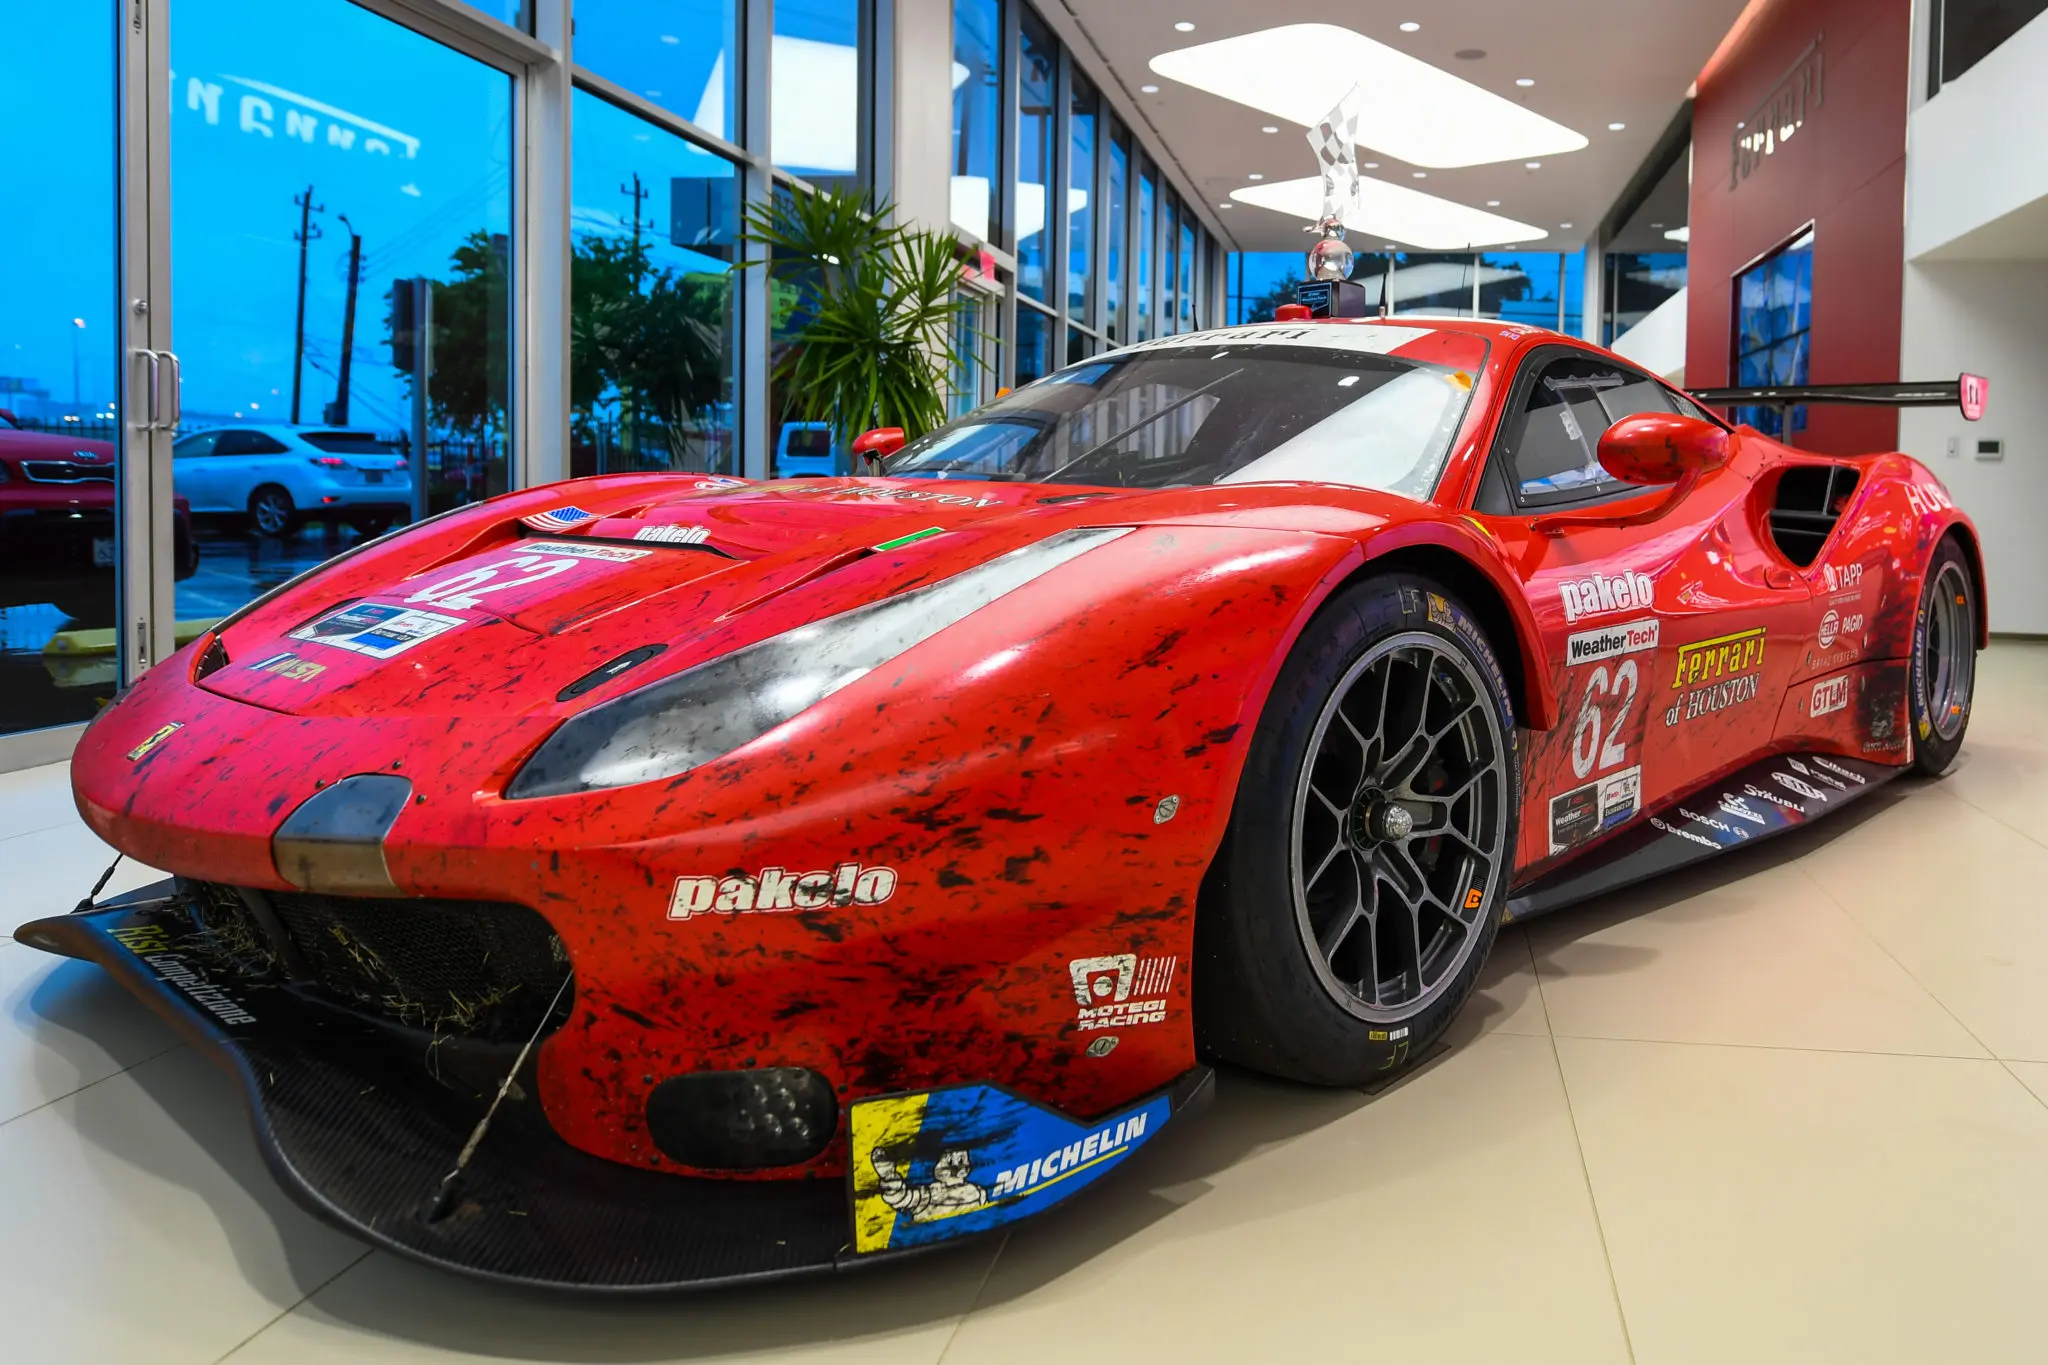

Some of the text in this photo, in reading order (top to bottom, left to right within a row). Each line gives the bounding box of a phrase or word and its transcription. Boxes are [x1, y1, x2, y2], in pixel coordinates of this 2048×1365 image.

[403, 555, 580, 610] 62
[1559, 568, 1654, 625] pakelo
[1835, 563, 1863, 590] TAPP
[1571, 625, 1658, 659] WeatherTech
[1842, 613, 1863, 634] PAGID
[1672, 626, 1768, 690] Ferrari
[1572, 658, 1639, 779] 62
[1665, 673, 1761, 728] of HOUSTON
[1812, 683, 1848, 712] GTLM
[1665, 822, 1724, 850] brembo
[1679, 807, 1730, 833] BOSCH
[667, 862, 899, 922] pakelo
[144, 951, 257, 1025] Competizione
[1078, 1000, 1166, 1020] MOTEGI
[1078, 1011, 1166, 1032] RACING
[991, 1112, 1147, 1198] MICHELIN
